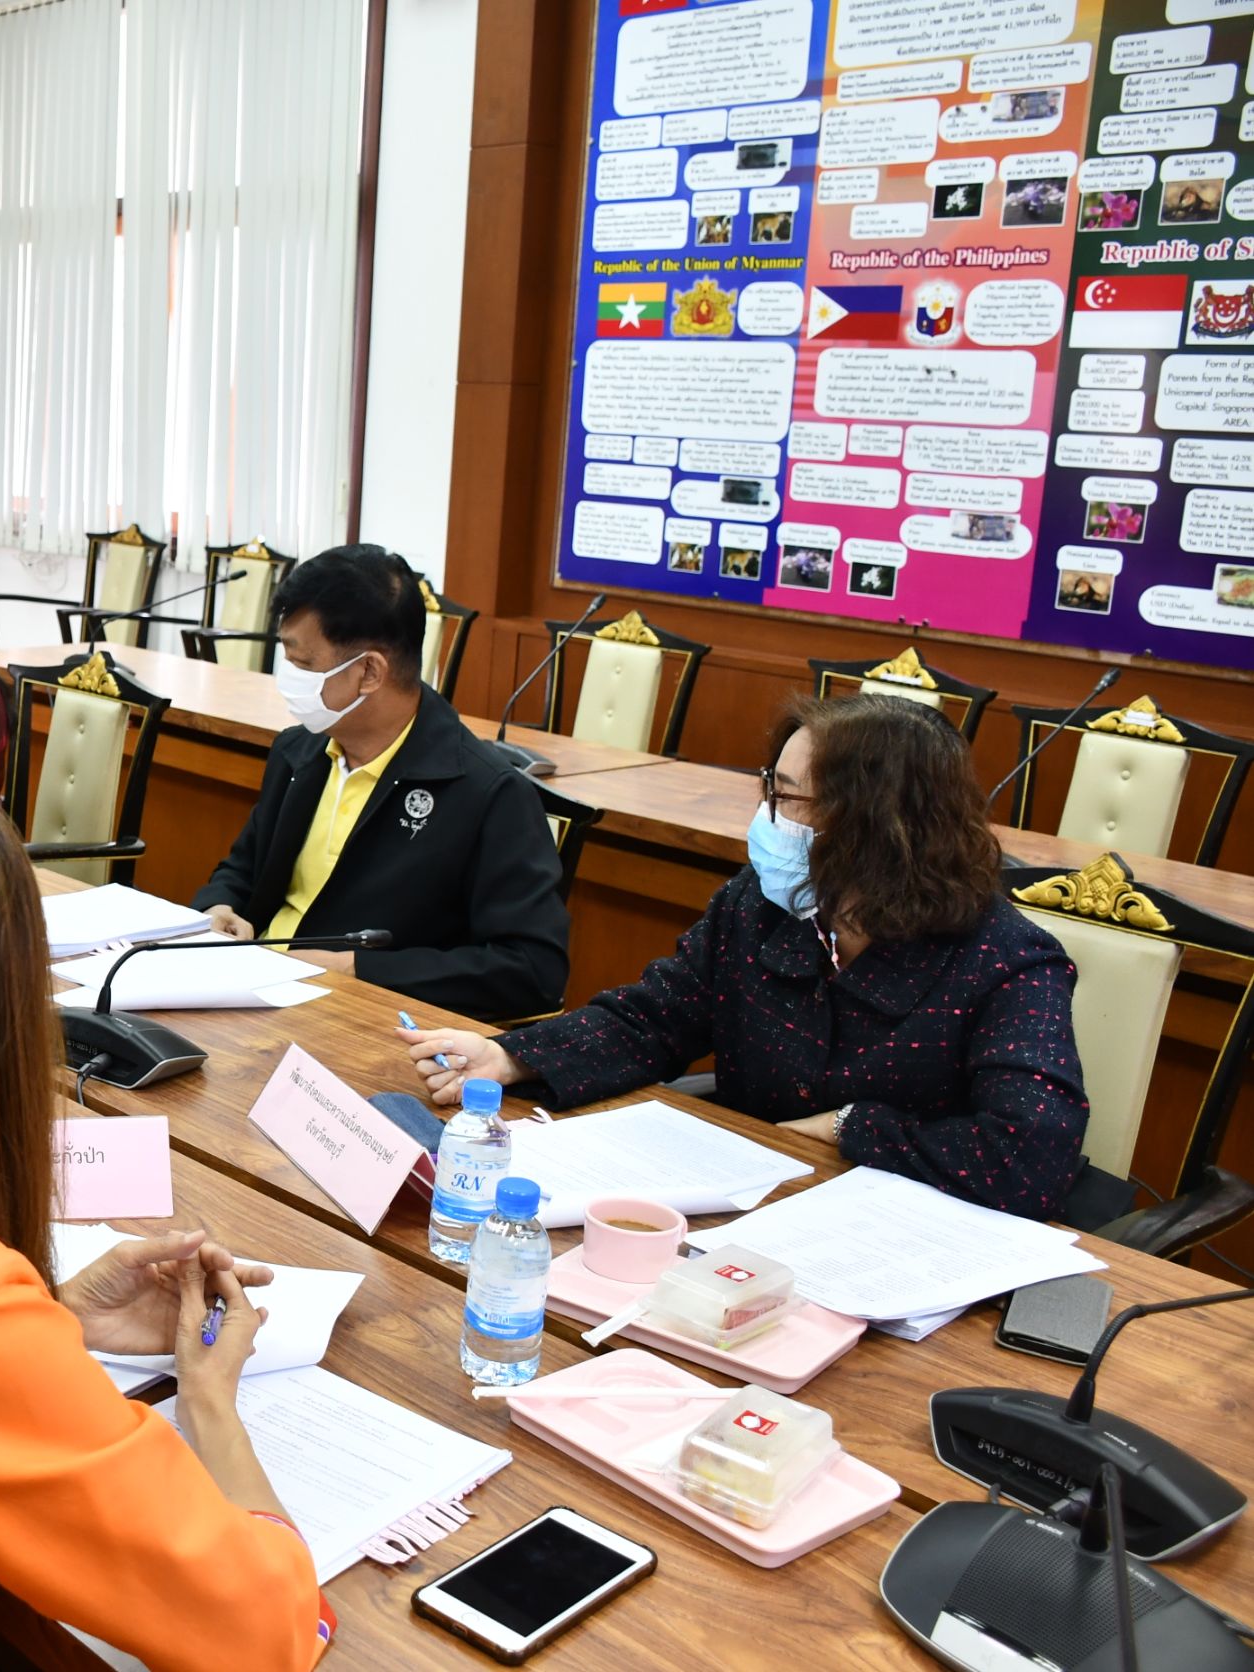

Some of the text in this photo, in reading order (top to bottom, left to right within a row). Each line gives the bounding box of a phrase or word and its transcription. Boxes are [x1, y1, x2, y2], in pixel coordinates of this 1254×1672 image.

[831, 246, 1048, 271] Republic of the Philippines
[1101, 237, 1254, 267] Republic of S
[594, 256, 804, 275] Republic of the Union of Myanmar
[1204, 359, 1228, 369] Form
[1230, 358, 1241, 369] of
[1202, 372, 1221, 382] form
[1225, 373, 1239, 383] the
[1215, 389, 1254, 398] parliame
[305, 1117, 345, 1160] จังหวัดชลบุรี
[52, 1140, 105, 1164] ะกั่วป่า
[451, 1173, 486, 1191] RN
